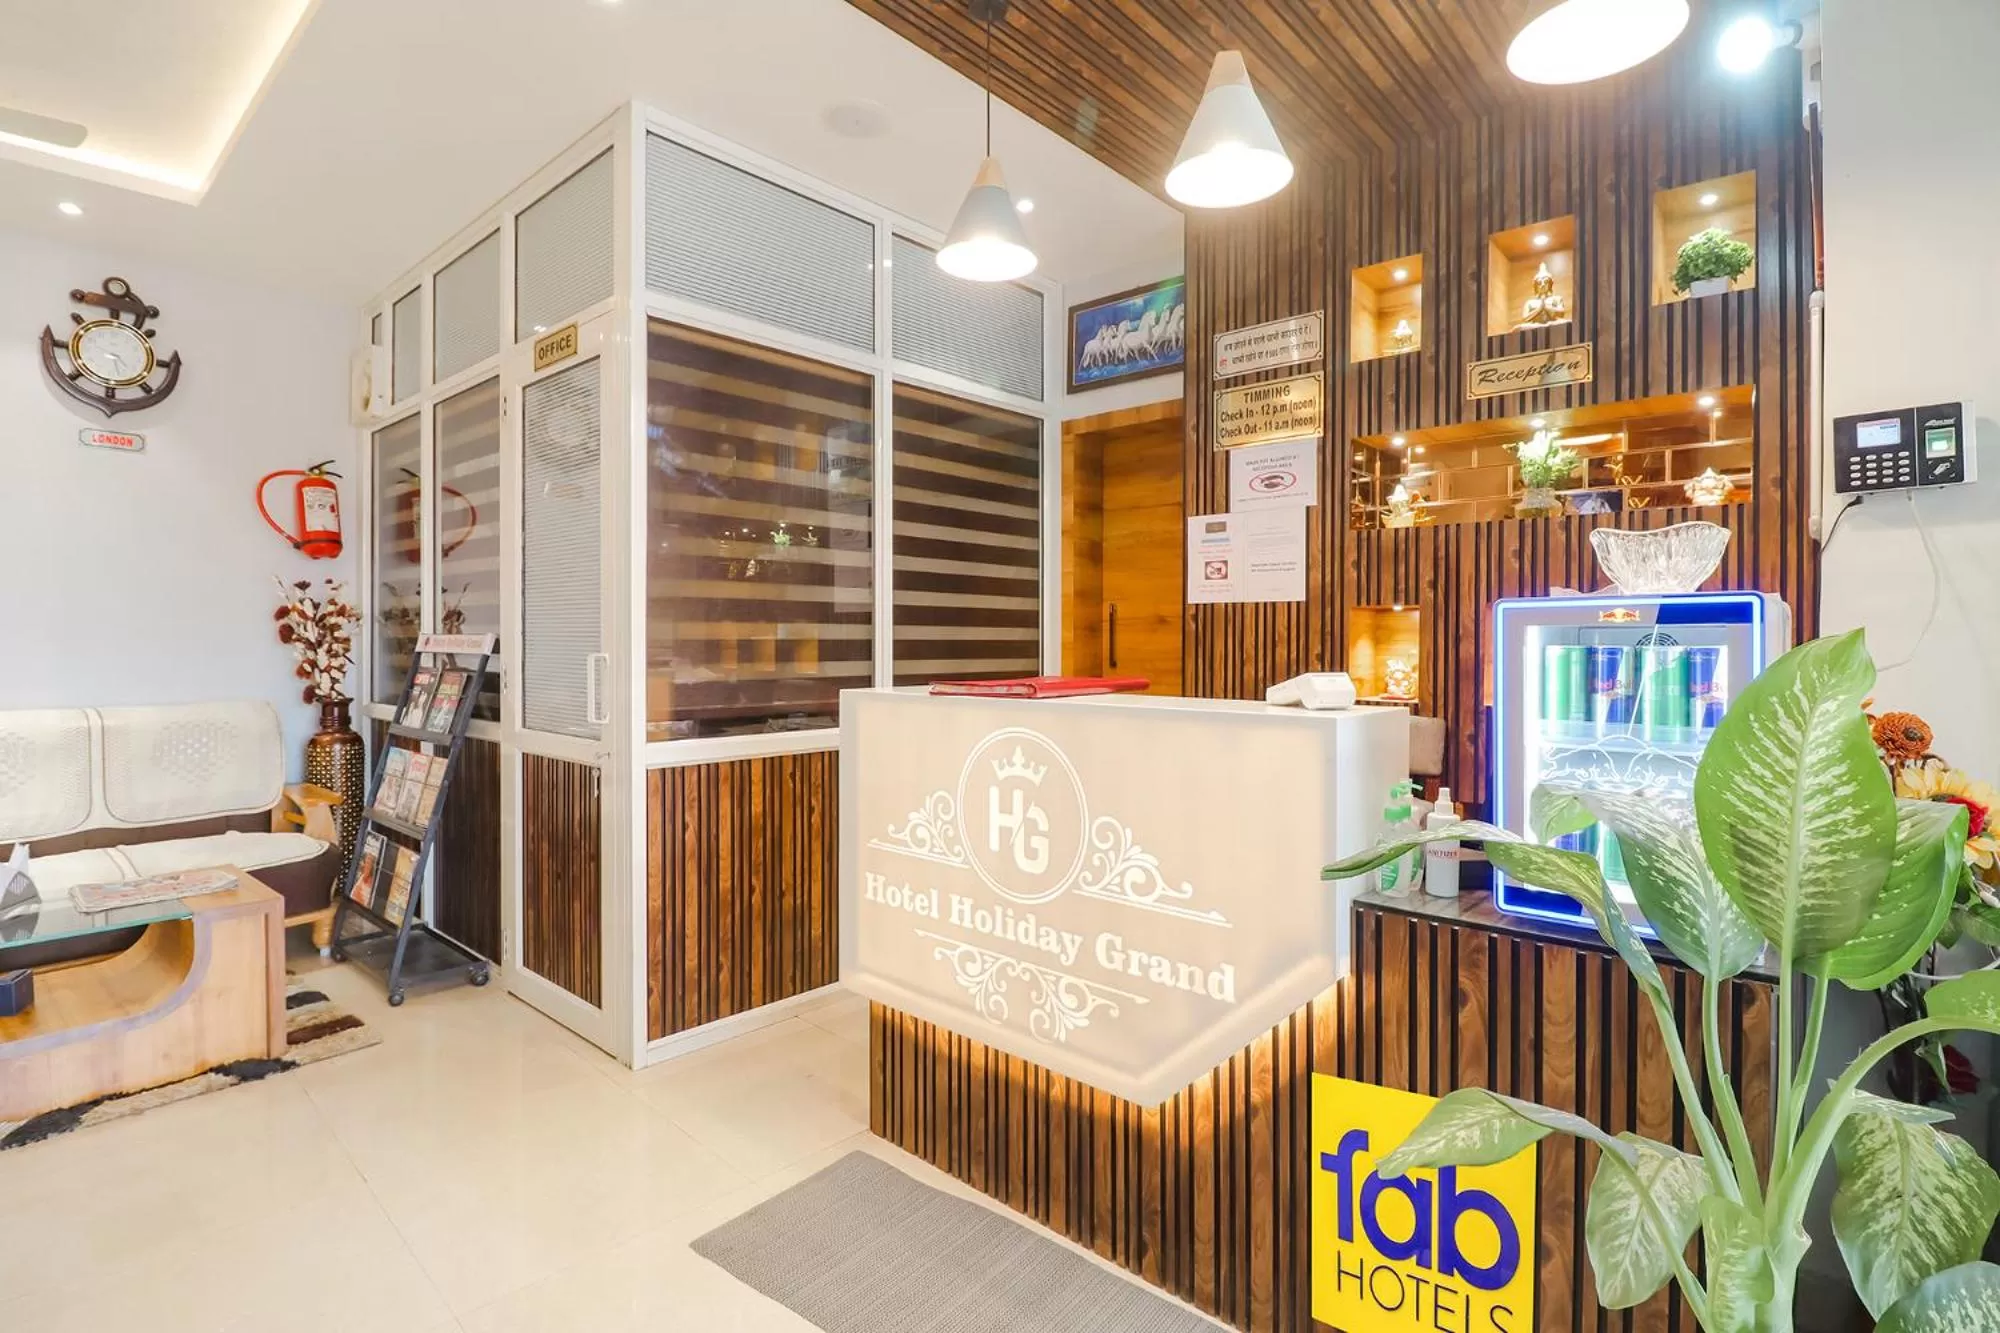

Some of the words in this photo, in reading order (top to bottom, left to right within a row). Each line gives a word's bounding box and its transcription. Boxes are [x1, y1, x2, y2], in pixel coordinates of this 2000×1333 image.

[538, 334, 572, 361] OFFICE
[1476, 359, 1582, 386] Reception
[1244, 385, 1290, 404] TIMMING
[1220, 408, 1243, 423] Check
[1246, 407, 1254, 419] In
[1261, 403, 1270, 416] 12
[1272, 402, 1288, 417] p.m
[1289, 396, 1317, 414] (noon)
[1220, 425, 1242, 439] Check
[1244, 422, 1258, 435] Out
[1264, 420, 1273, 432] 11
[1274, 419, 1289, 431] a.m
[1290, 413, 1317, 431] (noon)
[91, 433, 133, 448] LONDON
[988, 785, 1050, 875] HG
[864, 871, 940, 919] Hotel
[948, 893, 1084, 966] Holiday
[1095, 931, 1237, 1004] Grand
[1320, 1129, 1521, 1291] fab
[1337, 1250, 1514, 1333] HOTELS
